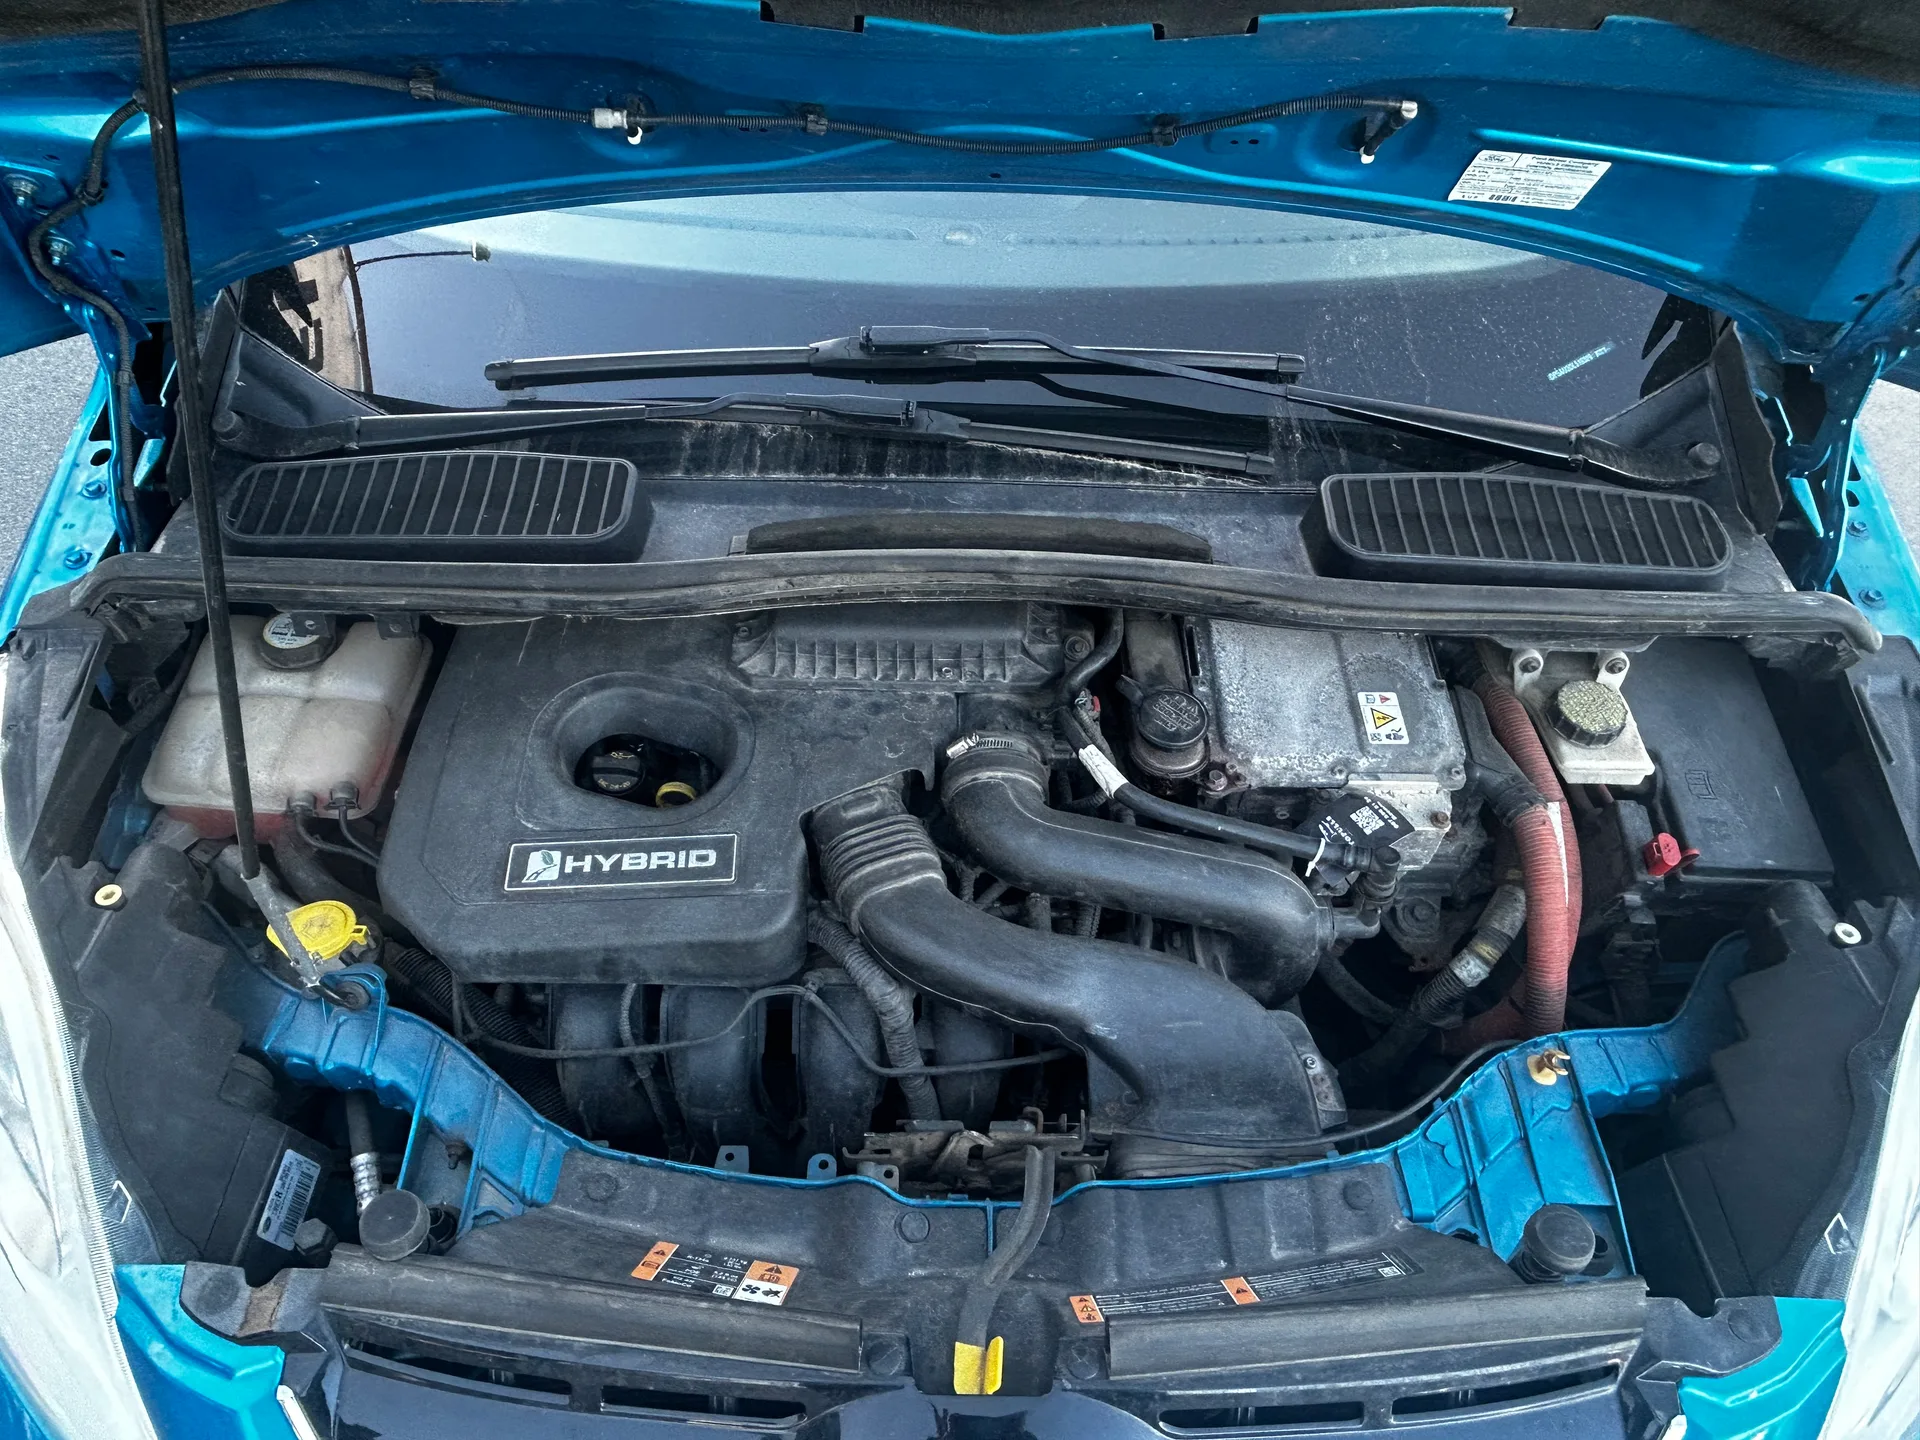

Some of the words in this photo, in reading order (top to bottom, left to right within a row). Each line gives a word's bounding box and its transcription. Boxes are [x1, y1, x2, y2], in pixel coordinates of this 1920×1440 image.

[1152, 702, 1194, 730] COOLANT
[564, 849, 717, 873] HYBRID
[274, 1190, 283, 1199] R
